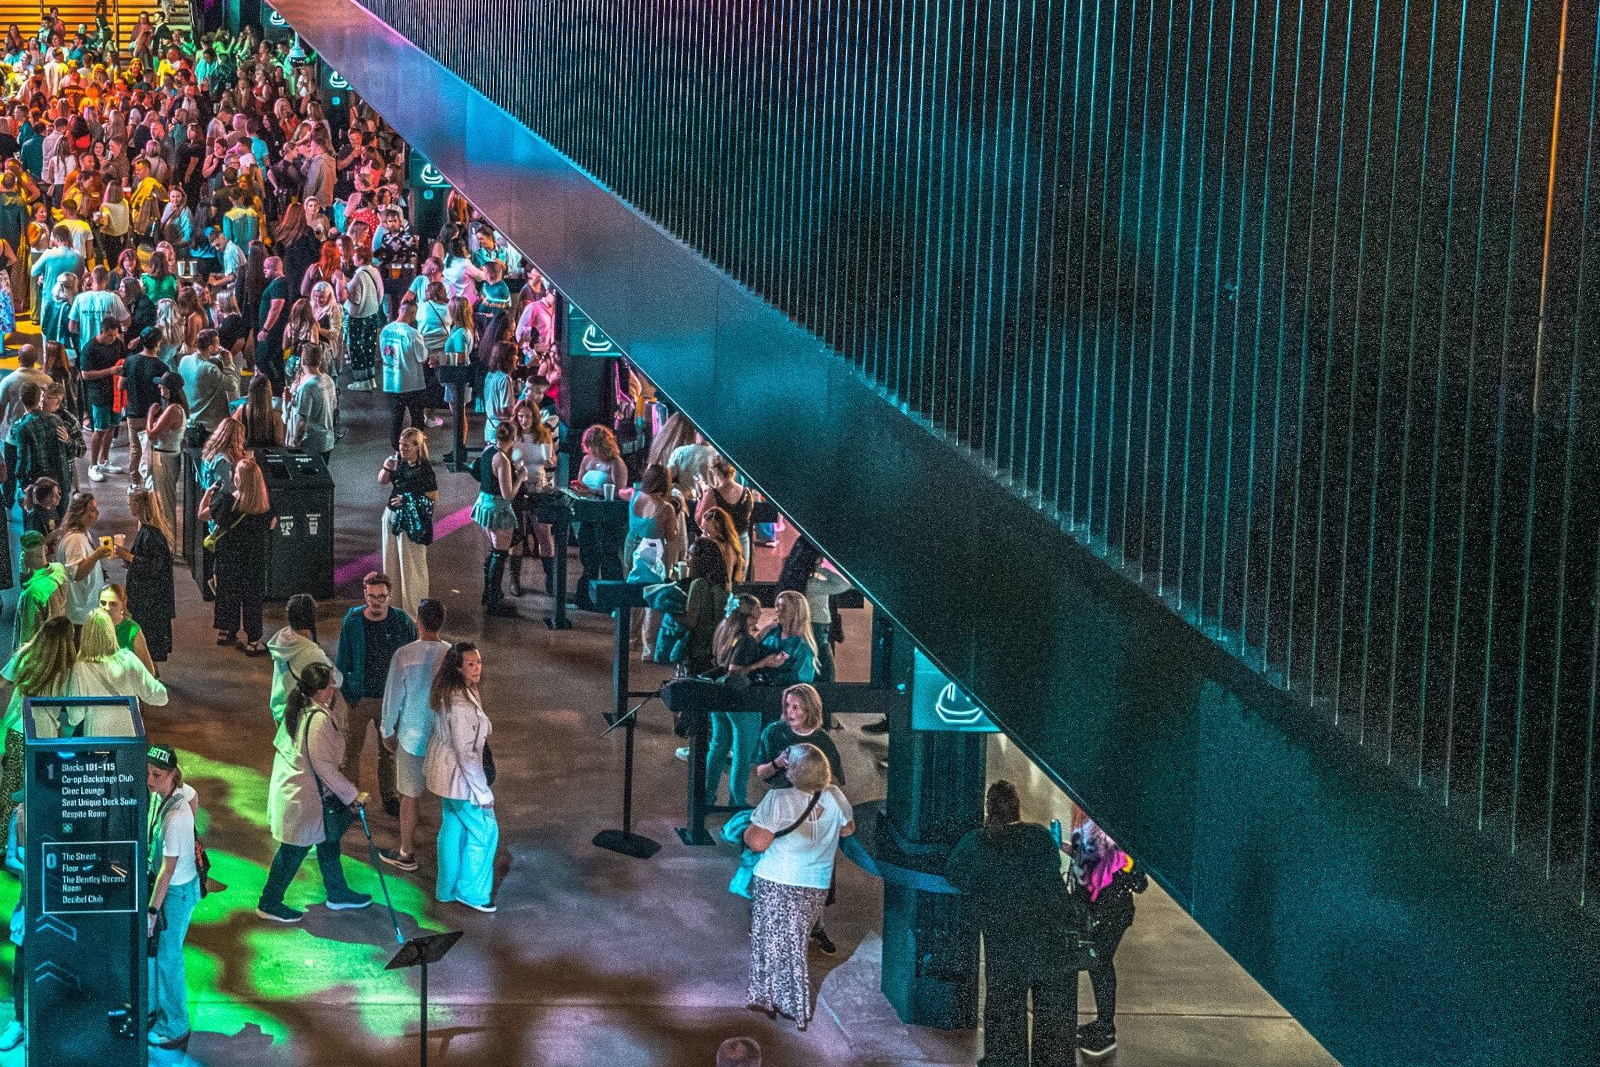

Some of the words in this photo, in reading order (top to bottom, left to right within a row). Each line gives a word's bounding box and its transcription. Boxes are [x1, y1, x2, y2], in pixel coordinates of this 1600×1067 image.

[61, 763, 84, 772] Blocks
[61, 775, 82, 784] Co-op
[83, 774, 117, 784] Backstage
[118, 774, 134, 783] Club
[80, 786, 105, 796] Lounge
[61, 798, 77, 807] Seat
[78, 798, 101, 807] Unique
[102, 797, 119, 806] Deck
[120, 797, 137, 806] Suite
[88, 810, 107, 818] Room
[62, 853, 75, 861] The
[75, 852, 96, 861] Street
[62, 864, 79, 872] Floor
[62, 875, 75, 884] The
[75, 875, 101, 885] Bentley
[62, 895, 87, 904] Decibel
[87, 895, 104, 903] Club
